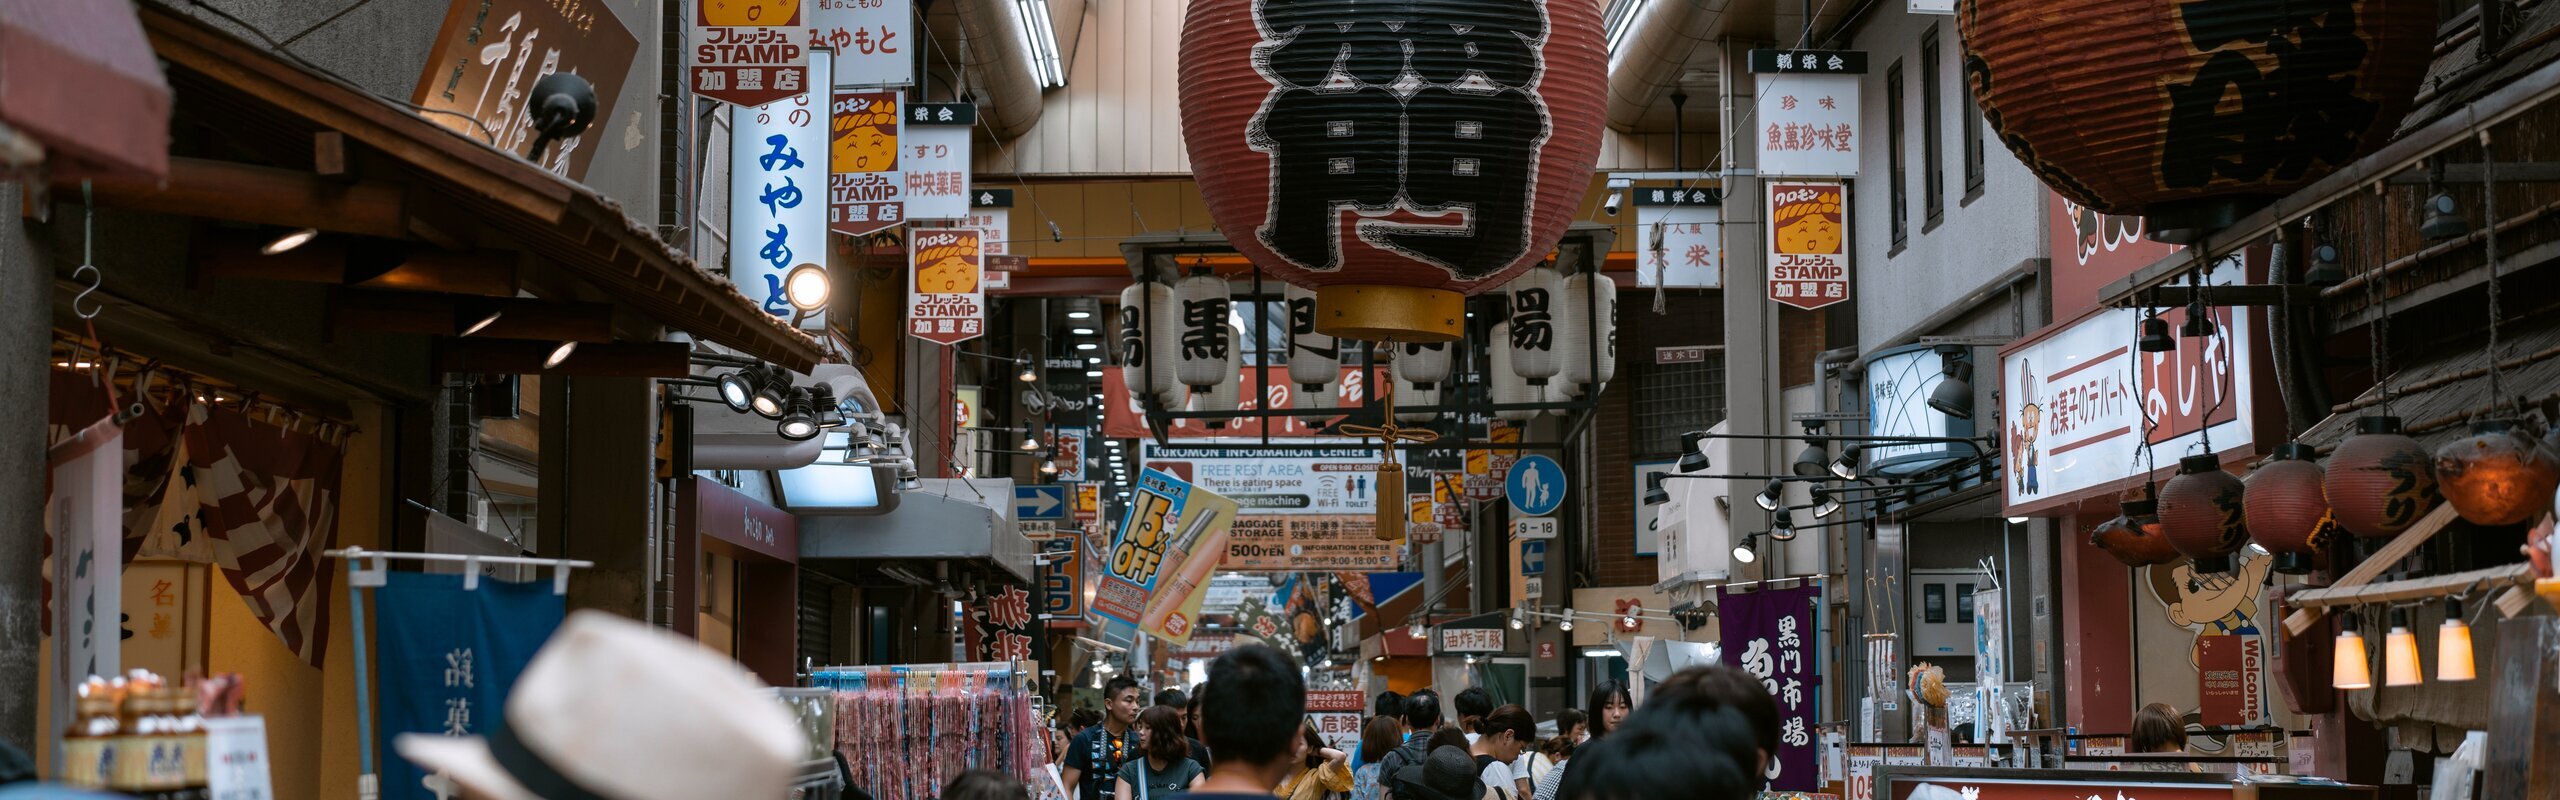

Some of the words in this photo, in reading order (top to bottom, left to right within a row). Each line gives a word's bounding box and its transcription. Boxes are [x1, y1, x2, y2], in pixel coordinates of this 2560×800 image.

[706, 27, 788, 44] フレッシュ
[809, 26, 897, 57] みやもと
[698, 44, 800, 63] STAMP
[1776, 53, 1844, 70] 親栄会
[699, 68, 801, 91] 加盟店
[1781, 95, 1836, 111] 珍味
[904, 107, 954, 122] 栄会
[905, 171, 963, 198] 中央薬局
[833, 185, 898, 201] TAMP
[1775, 189, 1819, 206] クロモン
[760, 134, 805, 315] みやもと
[916, 235, 958, 249] クロモン
[1779, 254, 1835, 266] フレッシュ
[1774, 266, 1843, 280] STAMP
[1775, 282, 1843, 298] 加盟店
[919, 294, 971, 305] フレッシュ
[914, 305, 978, 317] STAMP
[914, 319, 978, 334] 加盟店
[1663, 350, 1699, 360] 送水口
[2051, 368, 2128, 437] お菓子のデパート
[1226, 449, 1313, 458] INFORMATION
[1320, 449, 1367, 458] CENTER
[1201, 464, 1231, 477] FREE
[1236, 464, 1264, 477] REST
[1267, 464, 1304, 477] AREA
[1204, 477, 1230, 487] There
[1231, 477, 1241, 487] is
[1242, 477, 1273, 489] eating
[1275, 479, 1302, 490] space
[1257, 495, 1301, 506] machine
[1317, 488, 1339, 498] FREE
[1231, 520, 1284, 529] BAGGAGE
[1230, 529, 1284, 537] STORAGE
[1110, 540, 1164, 585] OFF
[1778, 615, 1809, 747] 黒門市場
[2244, 639, 2260, 722] Welcome
[1321, 715, 1359, 734] 危険
